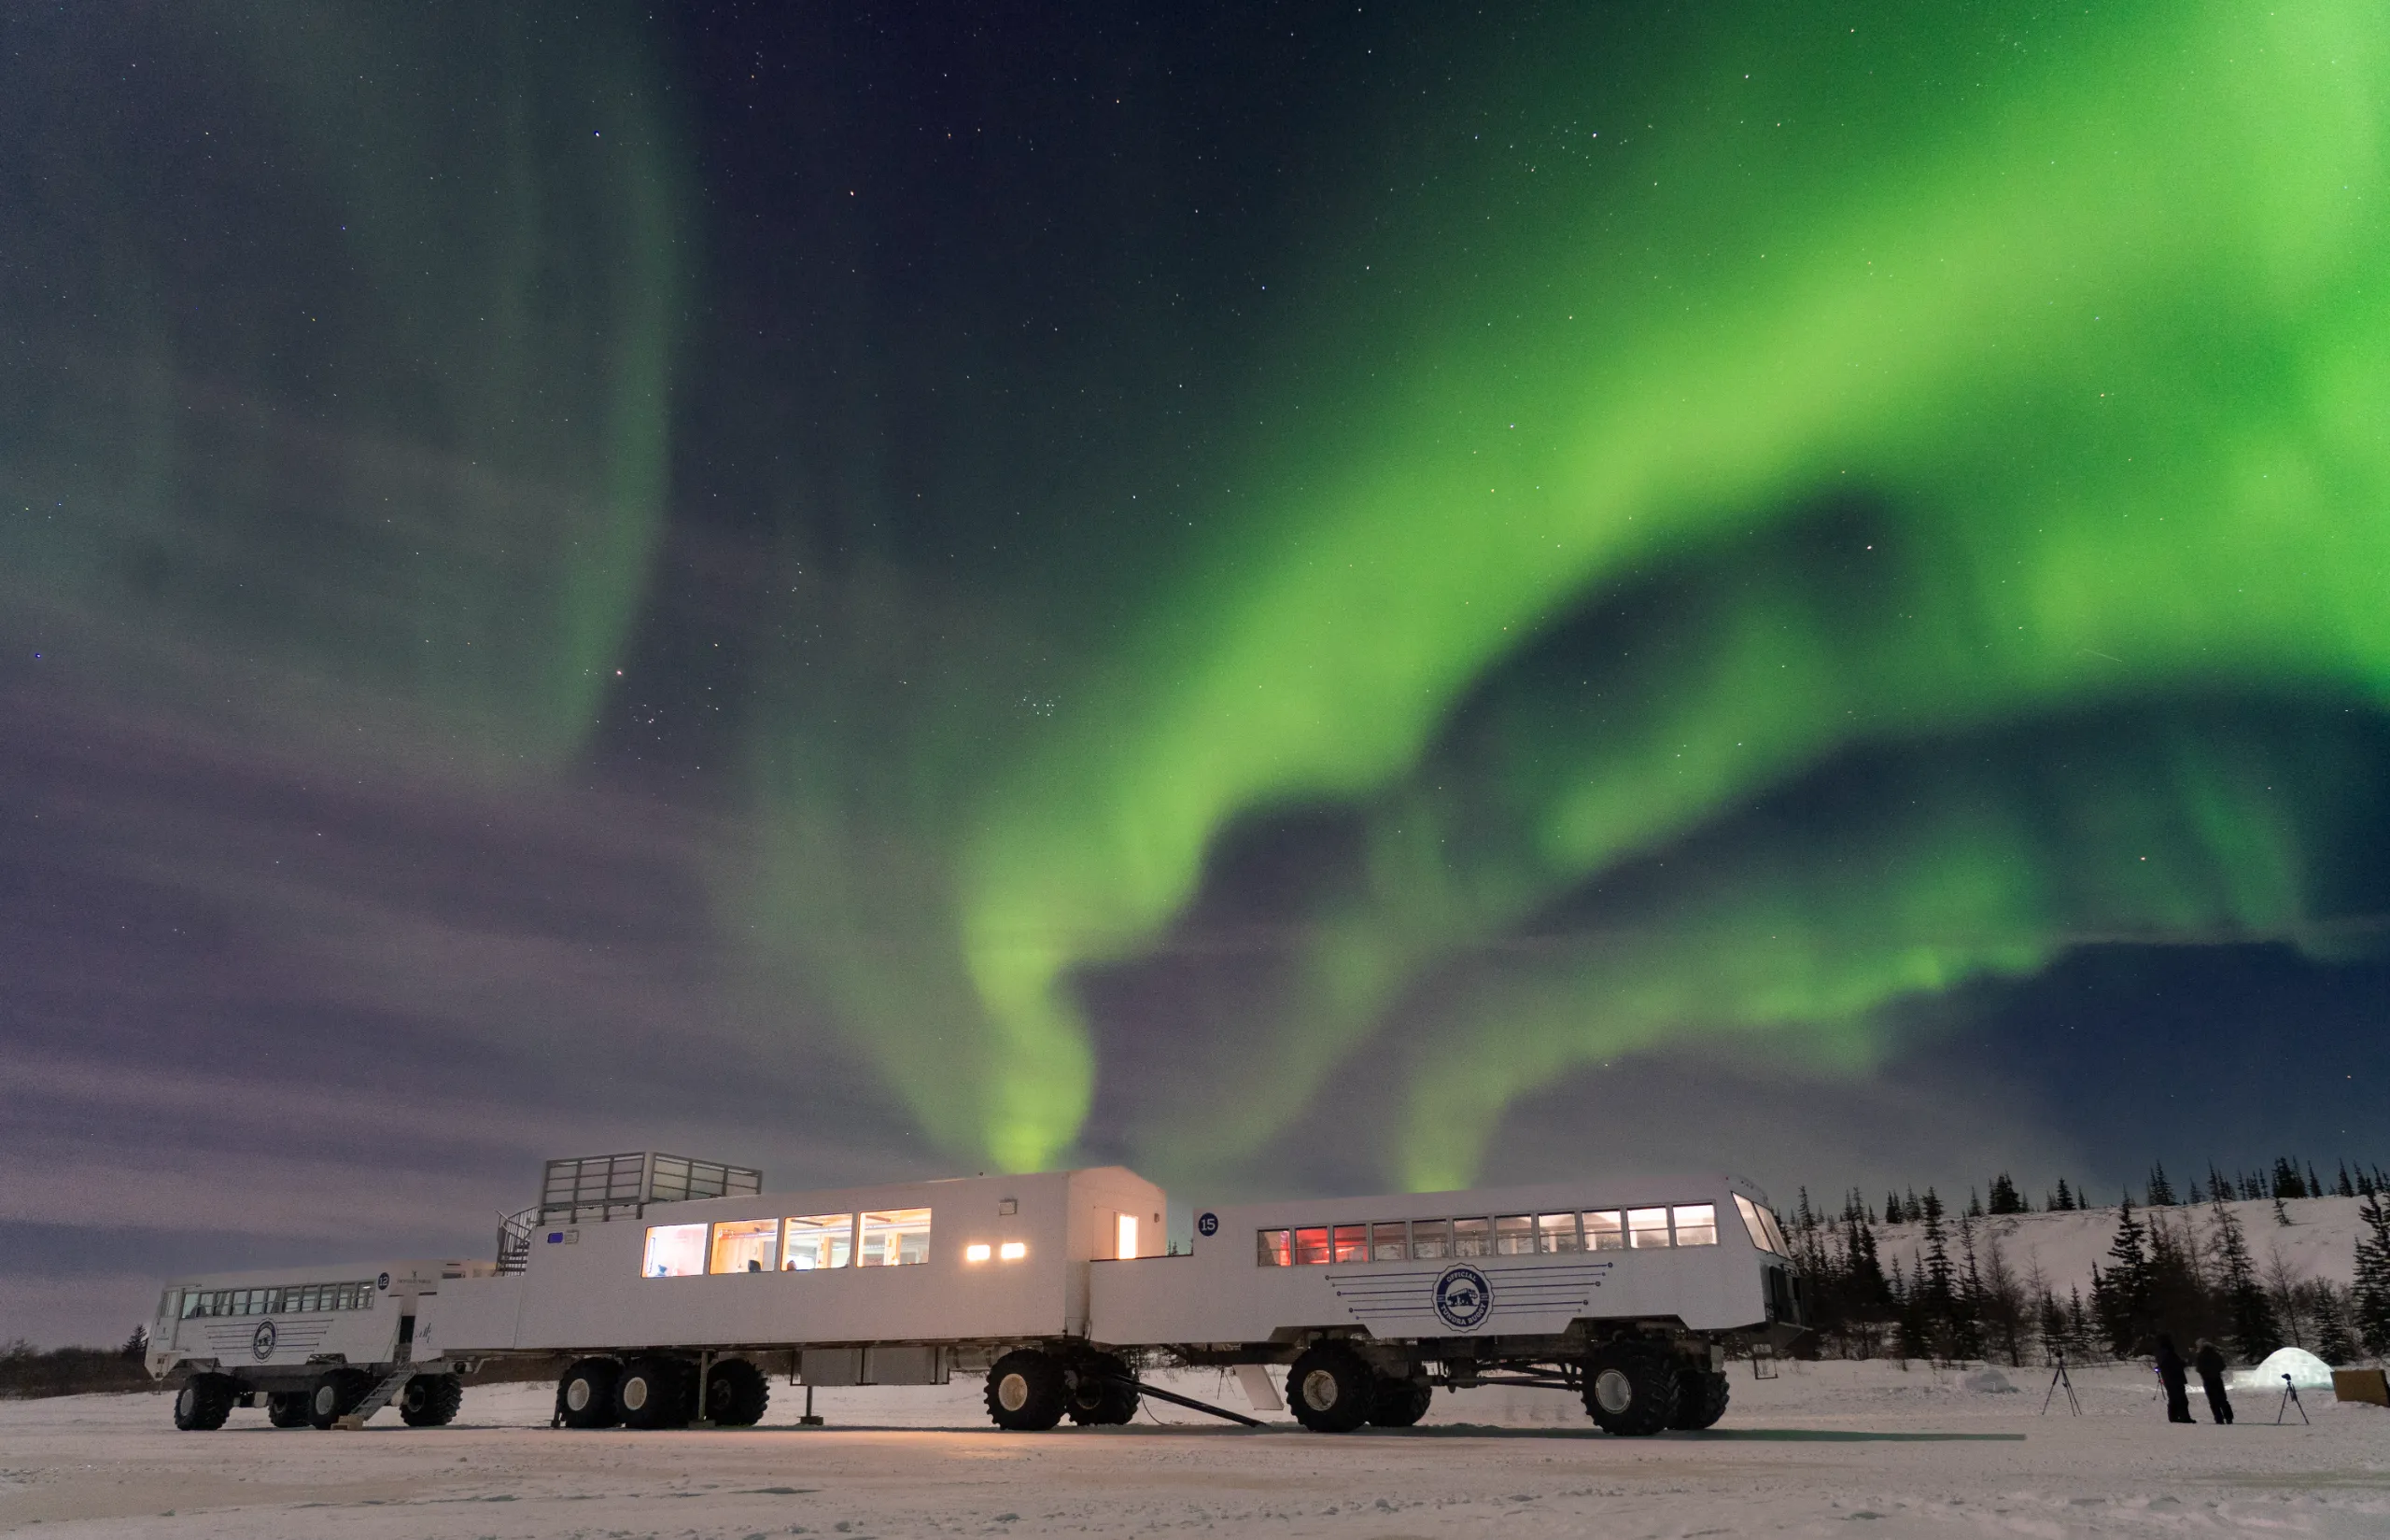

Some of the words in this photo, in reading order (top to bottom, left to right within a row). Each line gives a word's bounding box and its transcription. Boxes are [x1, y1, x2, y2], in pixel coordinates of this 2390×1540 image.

[1202, 1218, 1216, 1231] 15
[378, 1276, 388, 1286] 12
[1446, 1271, 1477, 1282] OFFICIAL
[1441, 1304, 1467, 1325] TUNDRA
[1468, 1303, 1486, 1324] BUGGY
